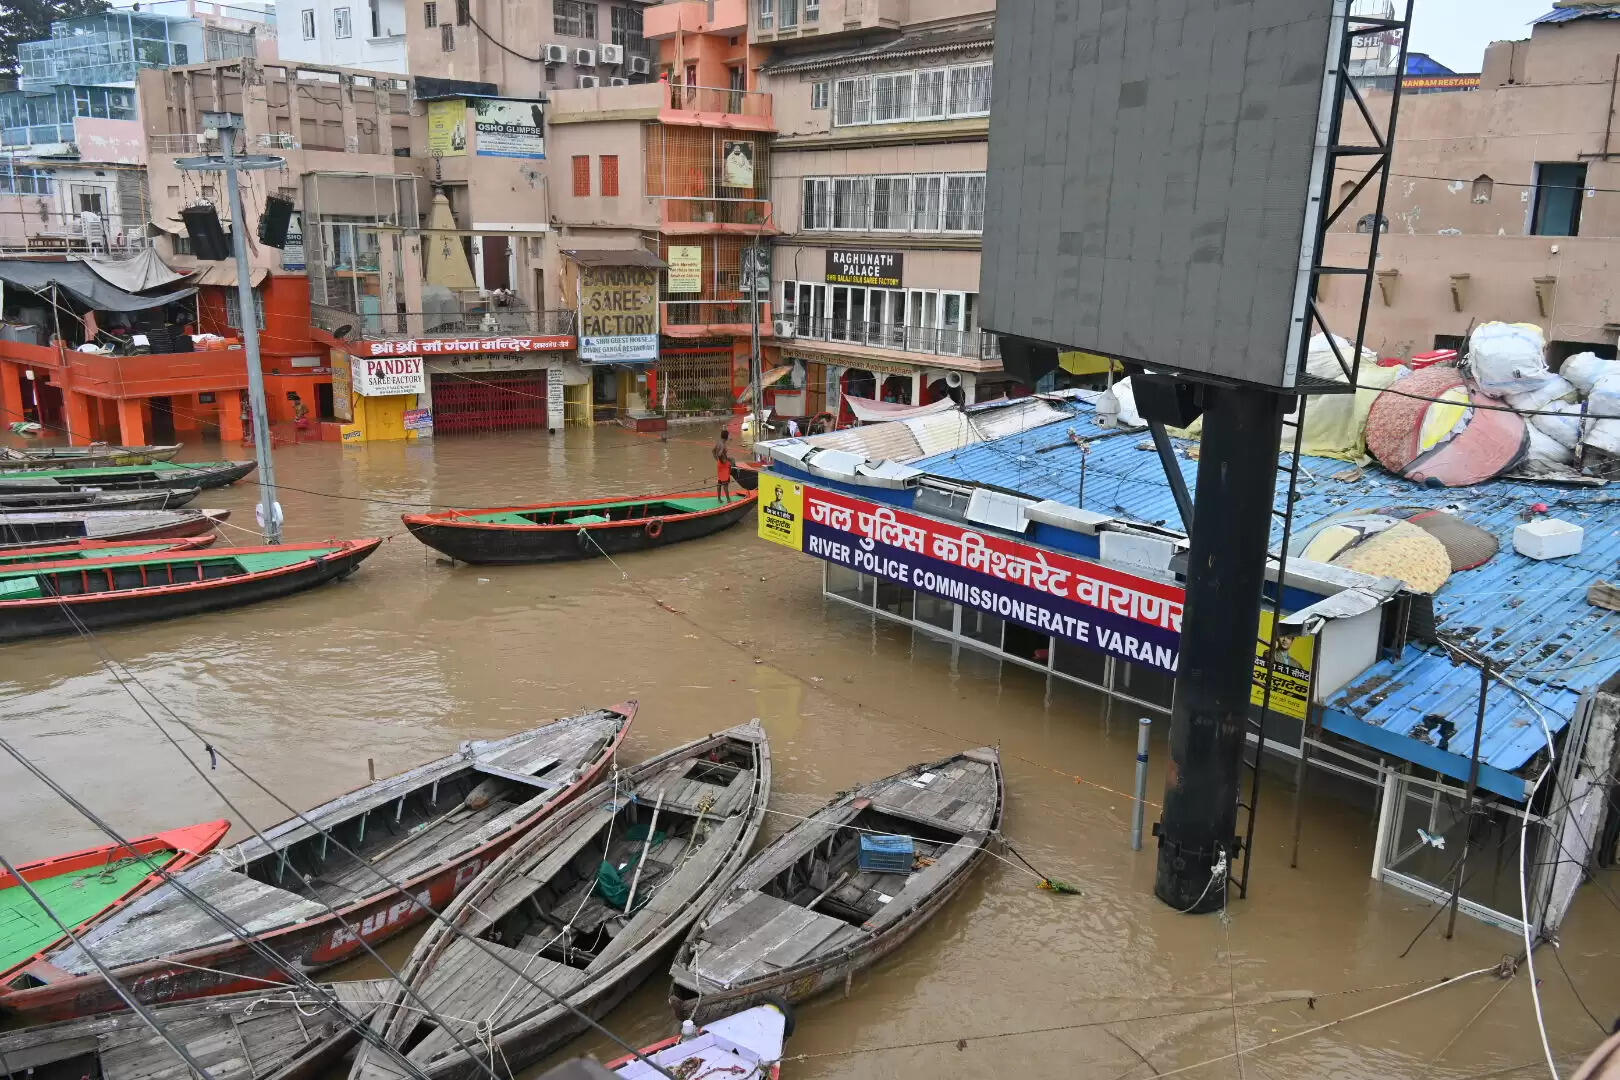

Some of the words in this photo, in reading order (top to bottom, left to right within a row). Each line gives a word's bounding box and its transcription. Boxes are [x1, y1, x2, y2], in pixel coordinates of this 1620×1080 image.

[478, 123, 504, 132] OSHO
[507, 125, 541, 135] GLIMPSE
[833, 252, 894, 266] RAGHUNATH
[843, 264, 880, 277] PALACE
[863, 276, 878, 285] SAREE
[878, 277, 900, 286] FACTORY
[591, 290, 642, 312] SAREE
[583, 314, 655, 337] FACTORY
[367, 358, 422, 376] PANDEY
[808, 498, 854, 532] जल
[857, 508, 927, 553] पुलिस
[932, 531, 1071, 597] कमिश्नरेट
[809, 535, 850, 564] RIVER
[854, 549, 909, 582] POLICE
[913, 568, 1090, 642] COMMISSIONERATE
